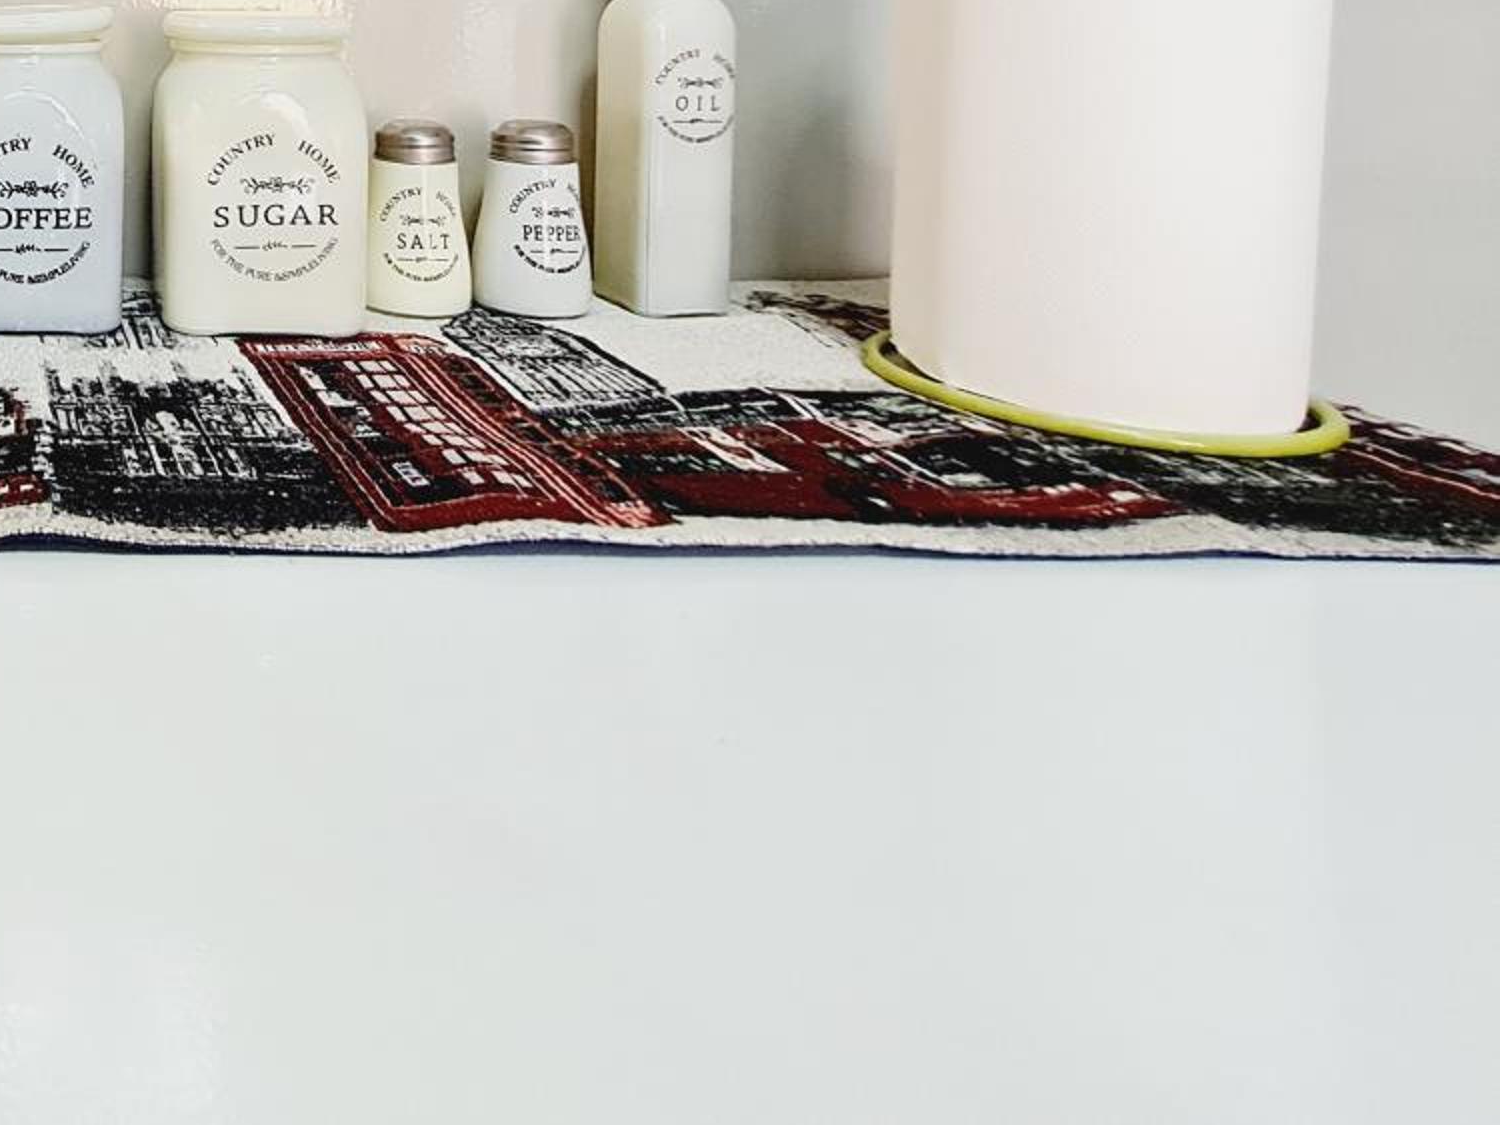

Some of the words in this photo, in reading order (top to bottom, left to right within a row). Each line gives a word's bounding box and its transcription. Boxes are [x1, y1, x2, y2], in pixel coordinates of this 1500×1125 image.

[675, 95, 720, 112] OIL
[51, 144, 95, 190] HOME
[207, 132, 276, 187] COUNTRY
[297, 139, 341, 185] HOME
[213, 204, 340, 228] SUGAR
[397, 232, 451, 250] SALT
[522, 224, 581, 242] PEPPER
